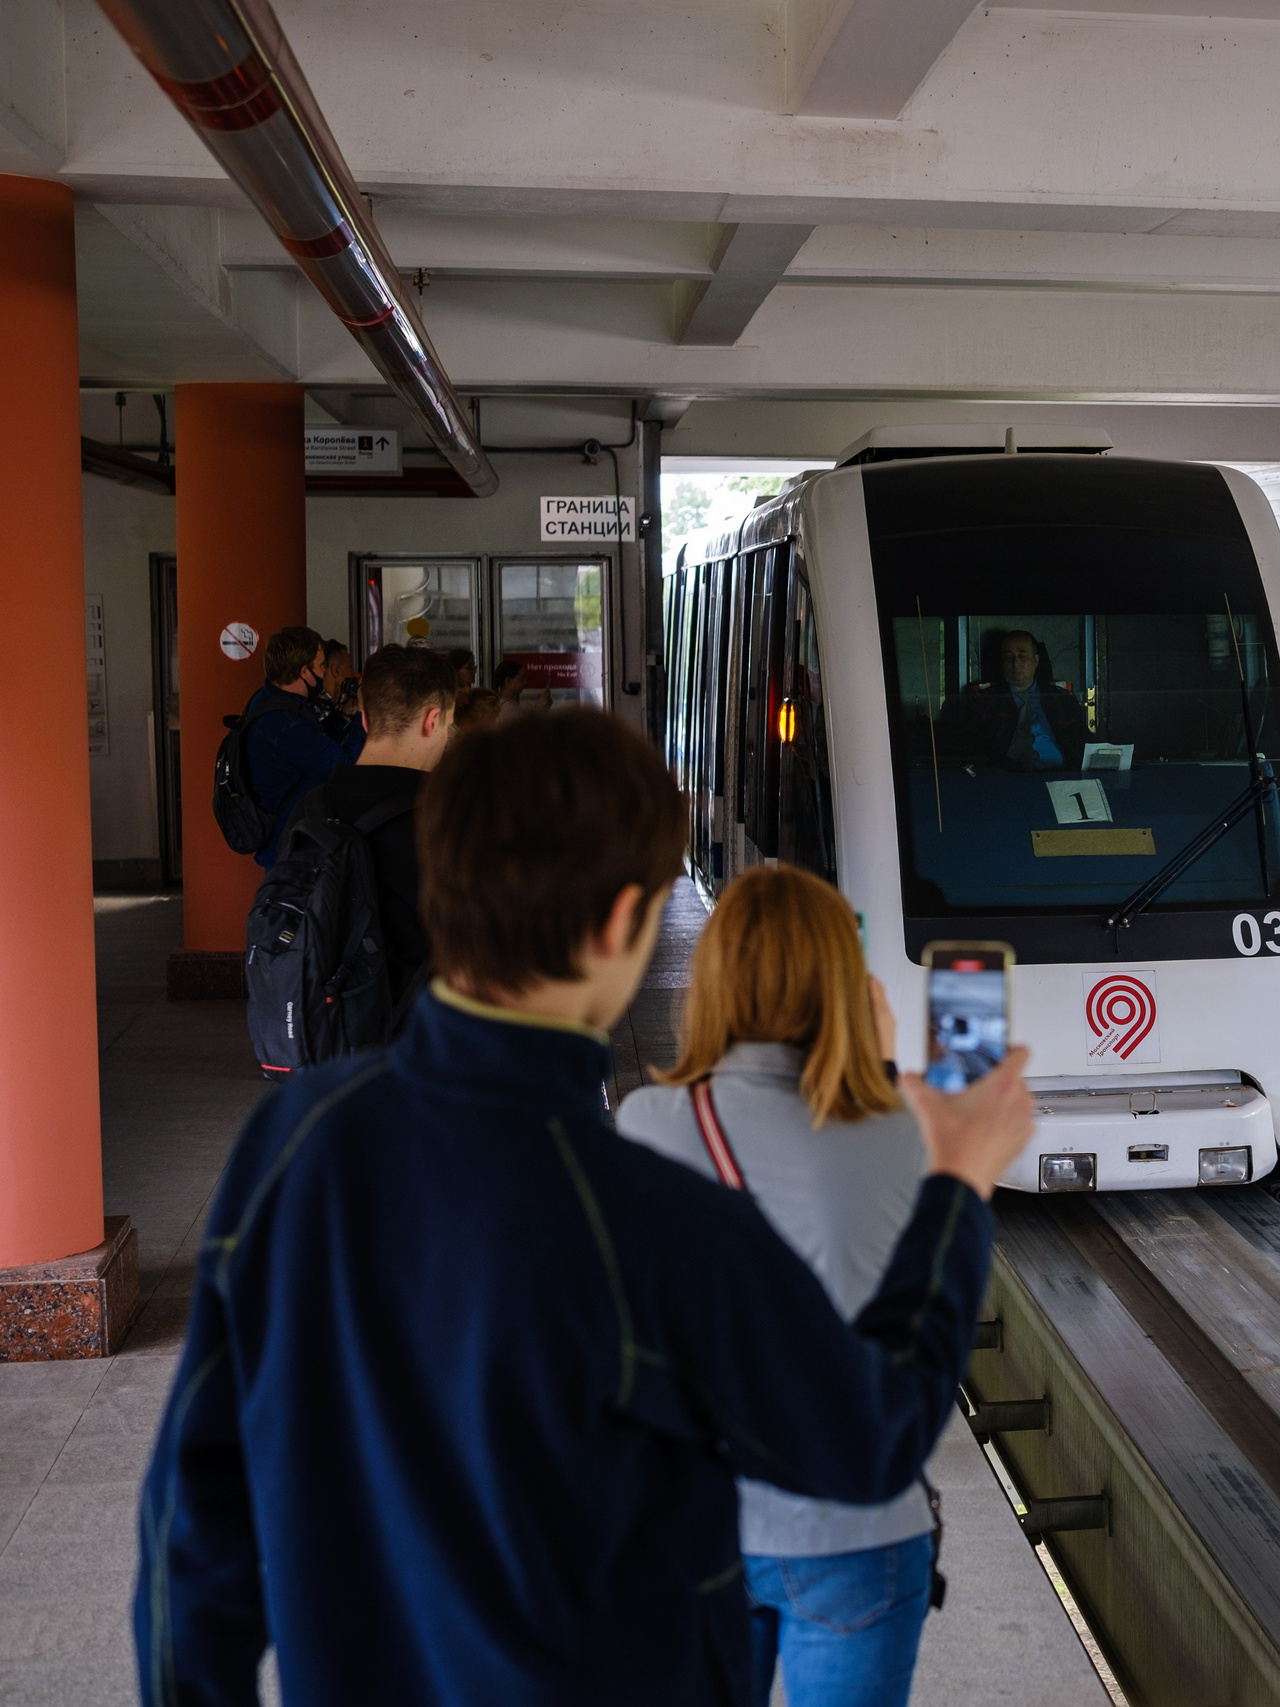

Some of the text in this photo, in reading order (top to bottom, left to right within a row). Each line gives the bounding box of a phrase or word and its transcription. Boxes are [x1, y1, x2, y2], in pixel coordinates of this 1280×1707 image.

[313, 435, 356, 445] Королёва
[546, 500, 630, 517] ГРАНИЦА
[545, 521, 630, 538] СТАНЦИИ
[527, 663, 577, 672] Нет прохода
[1068, 792, 1095, 821] 1
[1088, 1028, 1116, 1057] Московский
